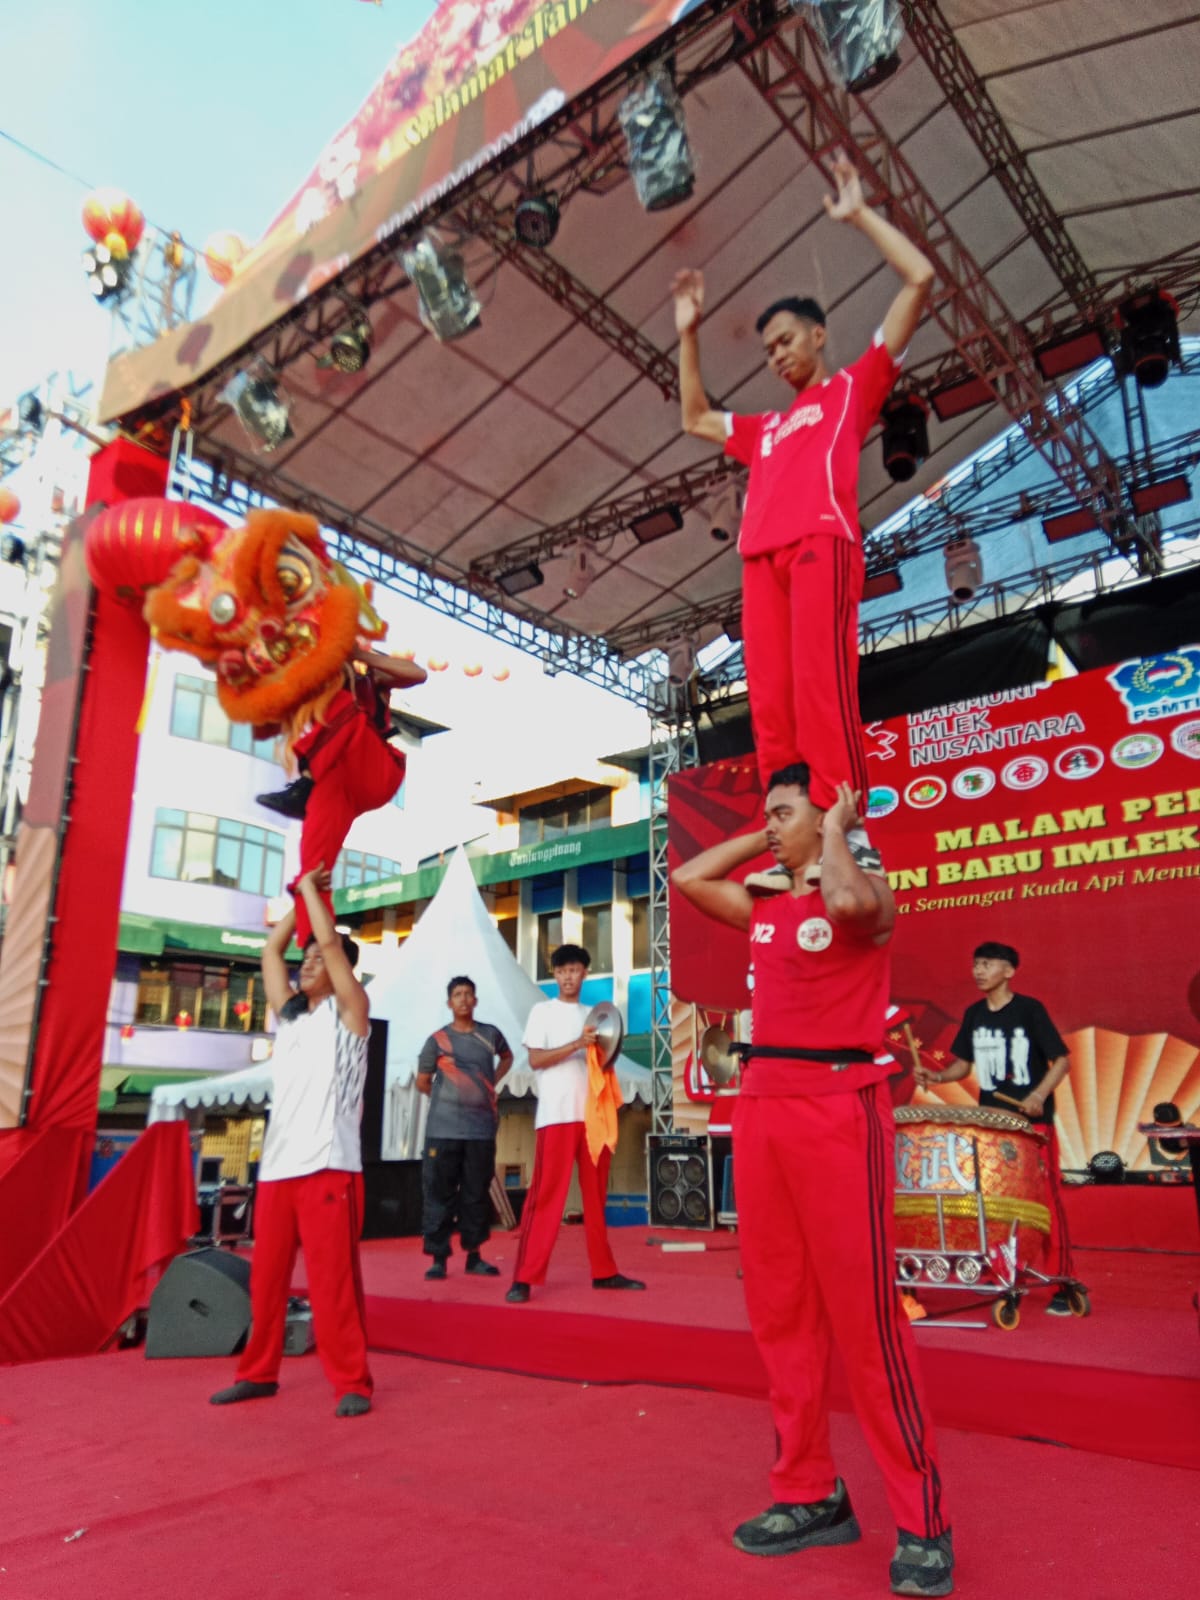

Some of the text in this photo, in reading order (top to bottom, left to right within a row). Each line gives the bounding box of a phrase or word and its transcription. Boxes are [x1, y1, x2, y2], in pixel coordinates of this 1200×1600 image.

[909, 710, 992, 746] IMLEK
[1133, 698, 1200, 721] PSMTI
[911, 712, 1086, 768] NUSANTARA
[935, 804, 1106, 853] MALAM
[936, 849, 1043, 885] BARU
[1051, 825, 1200, 868] IMLEK
[915, 887, 1014, 913] Semangat
[1021, 878, 1079, 899] Kuda
[1085, 871, 1126, 892] Api
